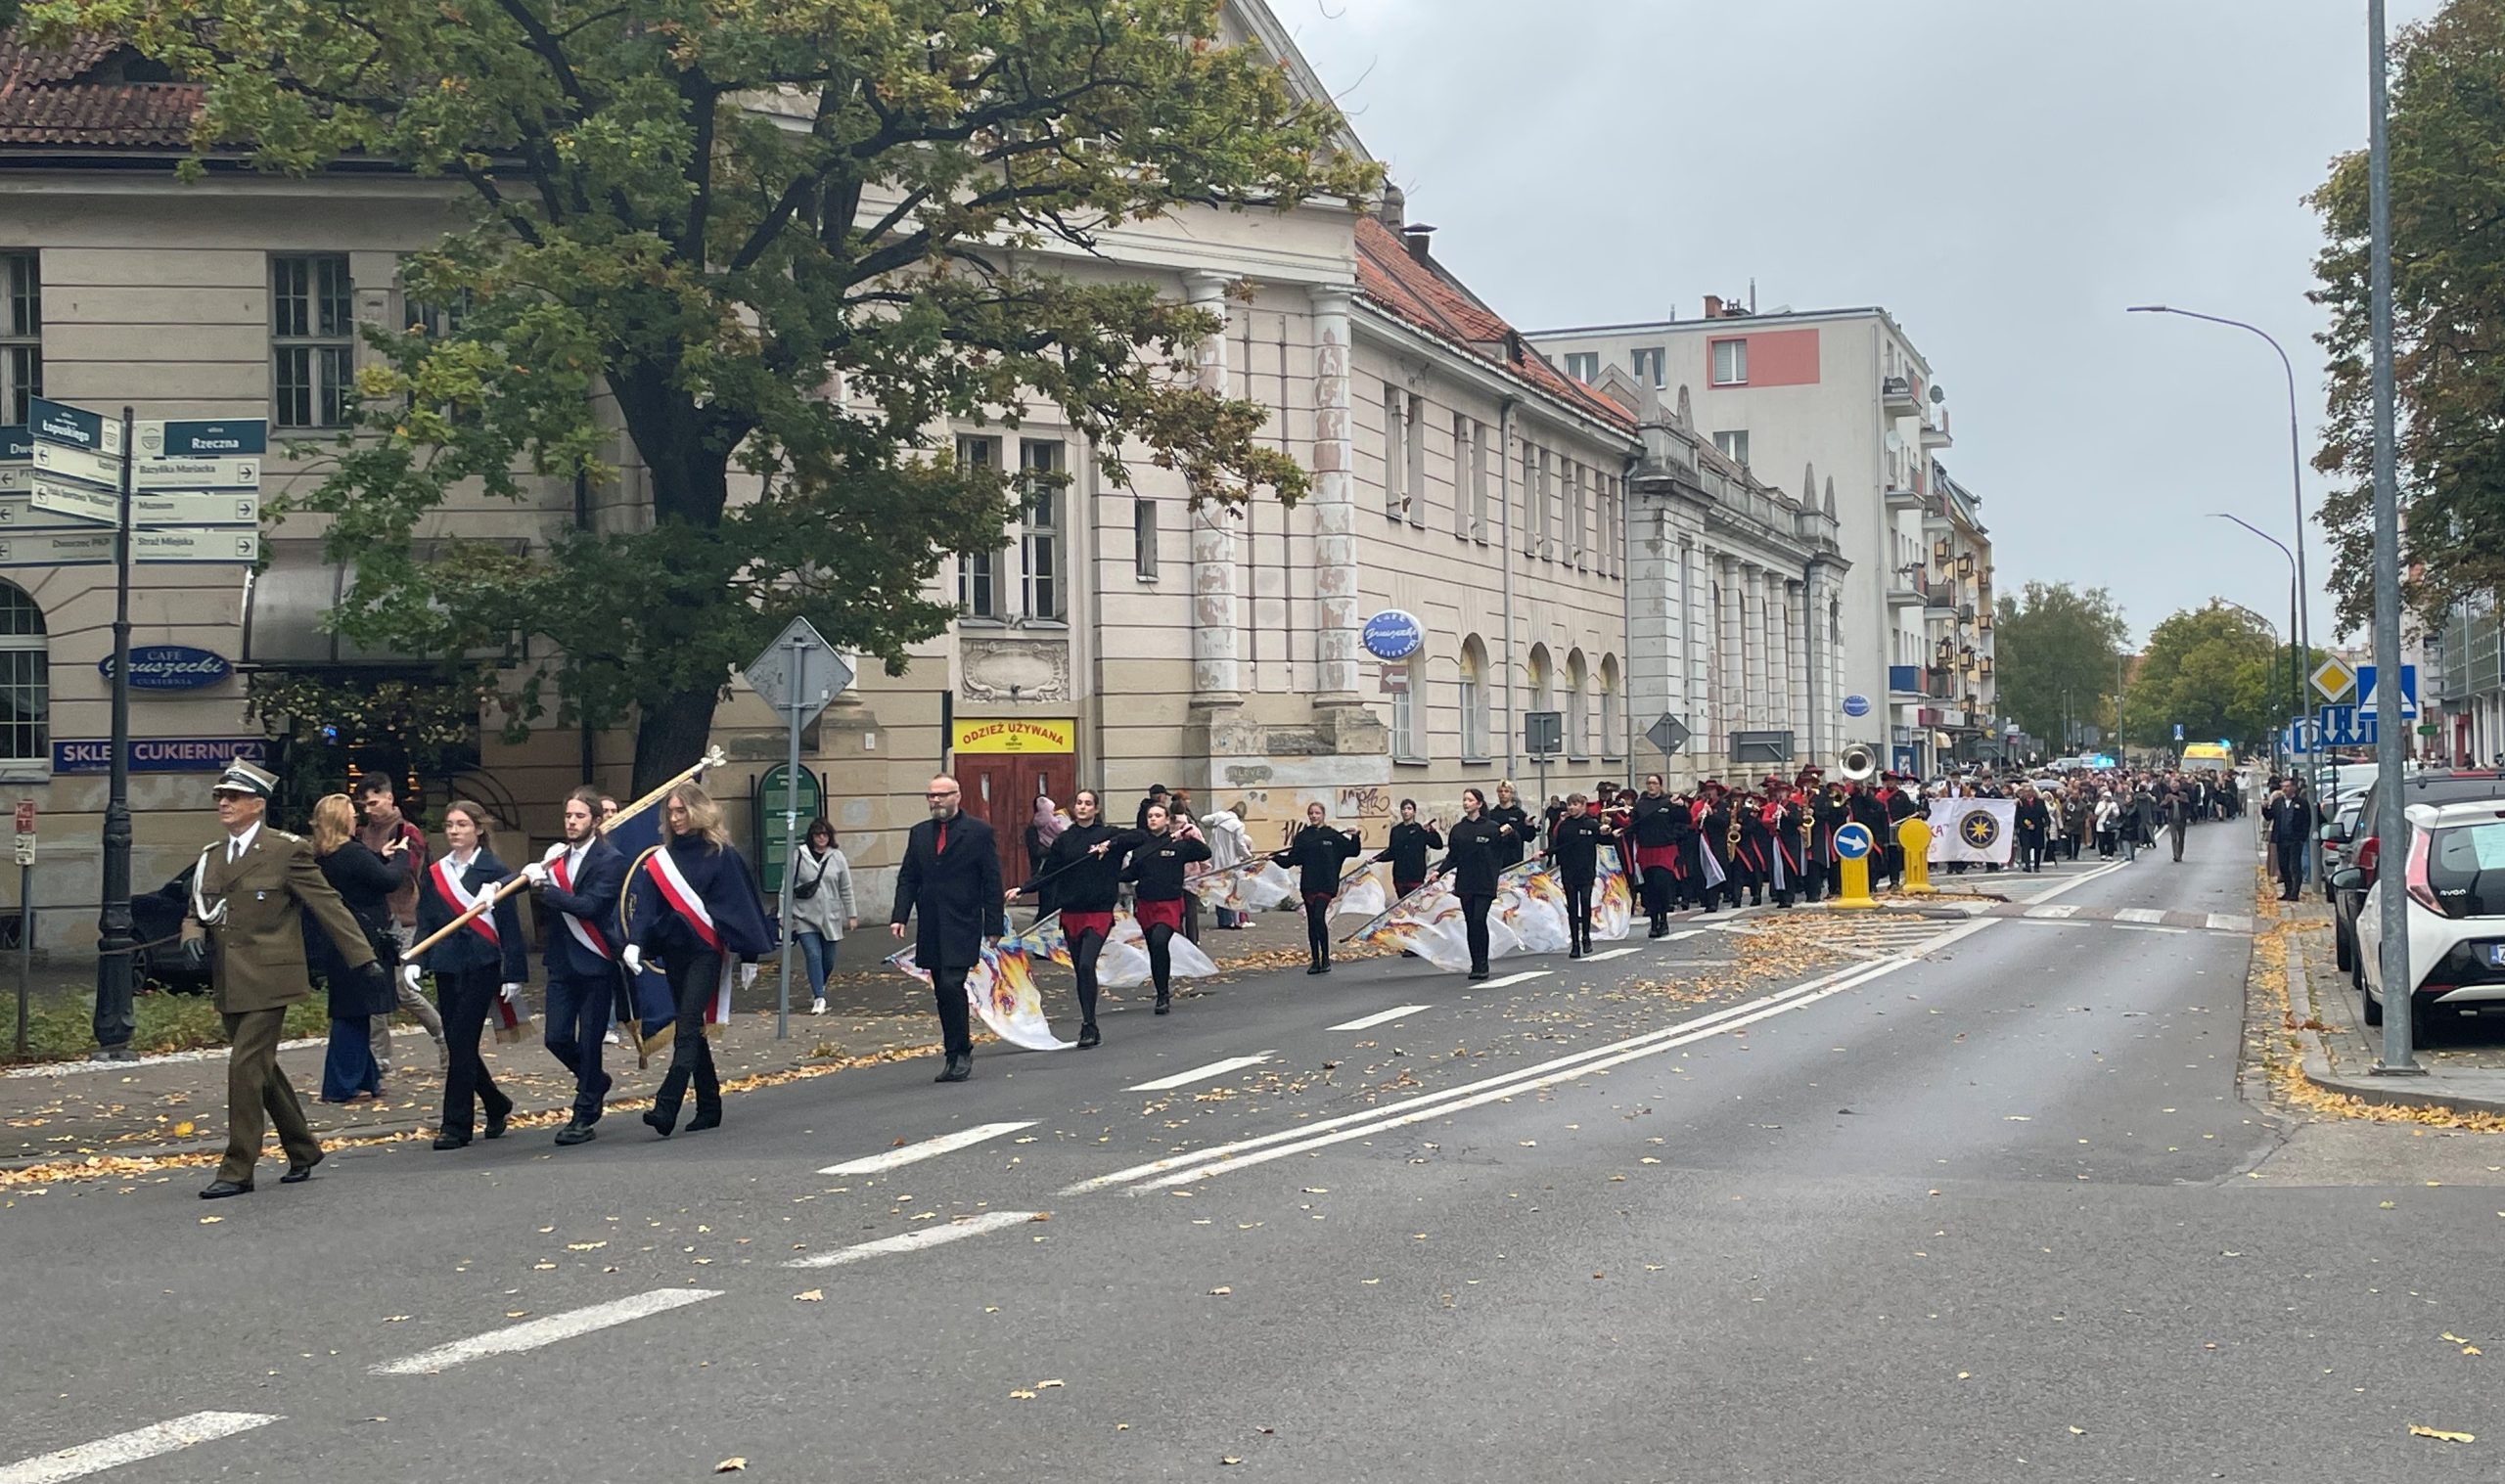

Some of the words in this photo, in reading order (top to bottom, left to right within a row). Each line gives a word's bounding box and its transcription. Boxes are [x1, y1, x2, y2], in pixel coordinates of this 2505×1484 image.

[191, 437, 240, 449] Rzeczna
[139, 465, 175, 474] Bazylika
[176, 464, 216, 473] Mariacka
[161, 536, 195, 547] Miejska
[963, 722, 1005, 744] ODZIEŻ
[1008, 722, 1064, 745] UŻYWANA
[134, 742, 266, 760] CUKIERNICZY
[2439, 888, 2467, 897] AYGO
